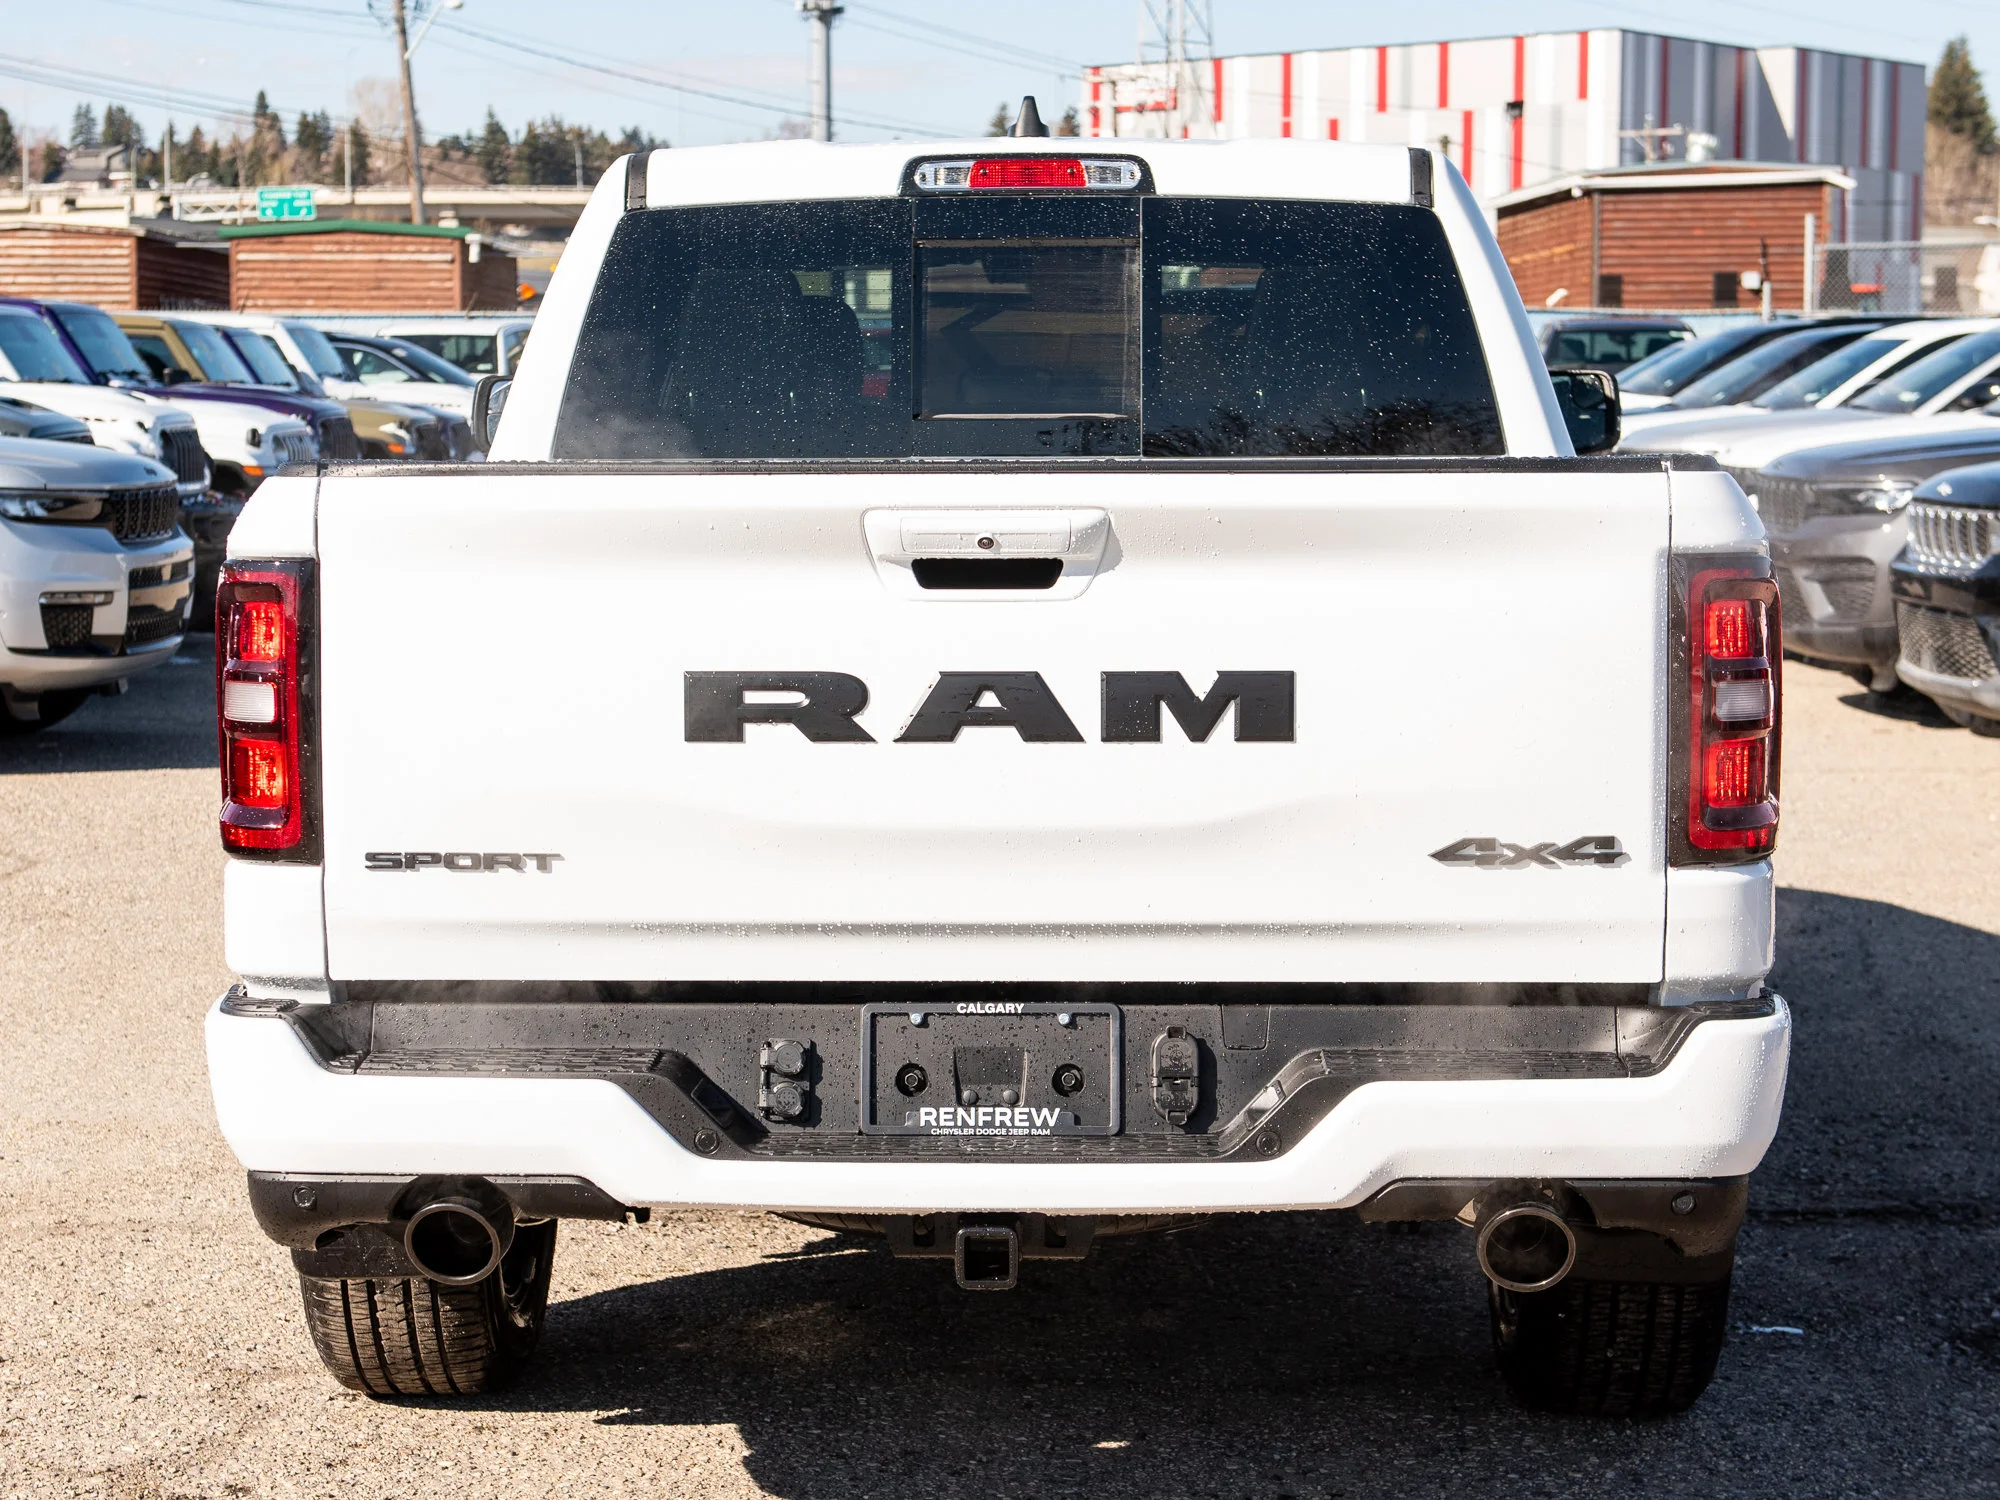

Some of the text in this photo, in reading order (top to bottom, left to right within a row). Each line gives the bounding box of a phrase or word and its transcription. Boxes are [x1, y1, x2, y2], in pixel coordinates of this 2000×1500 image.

[684, 670, 1296, 743] RAM
[1428, 836, 1626, 866] 4x4
[364, 852, 564, 873] SPORT
[956, 1002, 1025, 1014] CALGARY
[919, 1107, 1060, 1127] RENFREW
[930, 1128, 1051, 1136] CHRYSLER DODGE JEEP RAM
